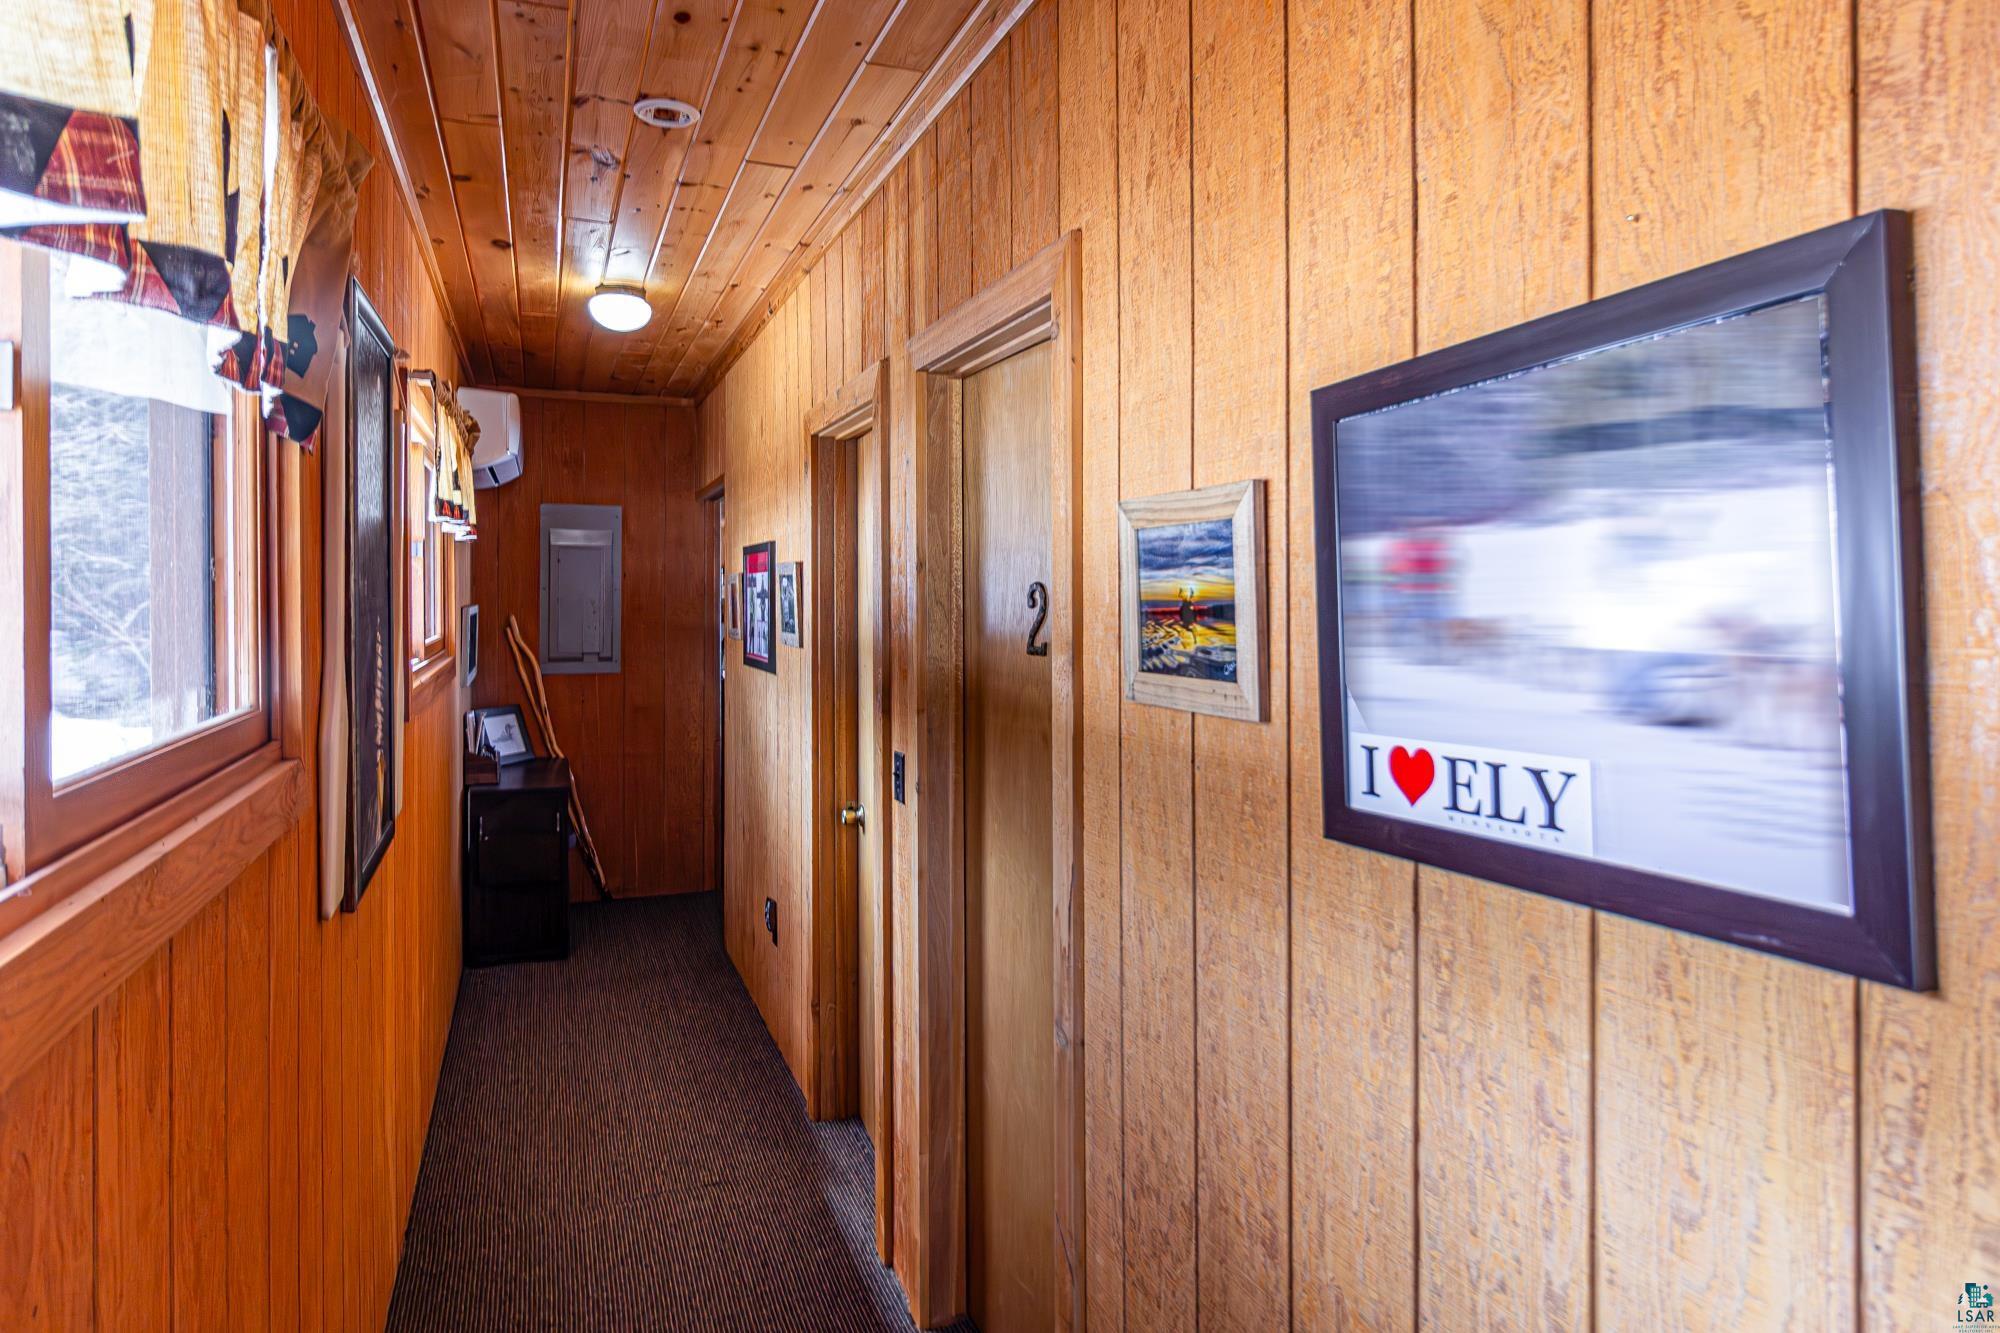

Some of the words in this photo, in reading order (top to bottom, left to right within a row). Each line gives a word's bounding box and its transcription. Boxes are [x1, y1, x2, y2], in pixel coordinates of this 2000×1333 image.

[1027, 582, 1048, 656] 2
[1360, 745, 1380, 797] I
[1442, 756, 1577, 832] ELY
